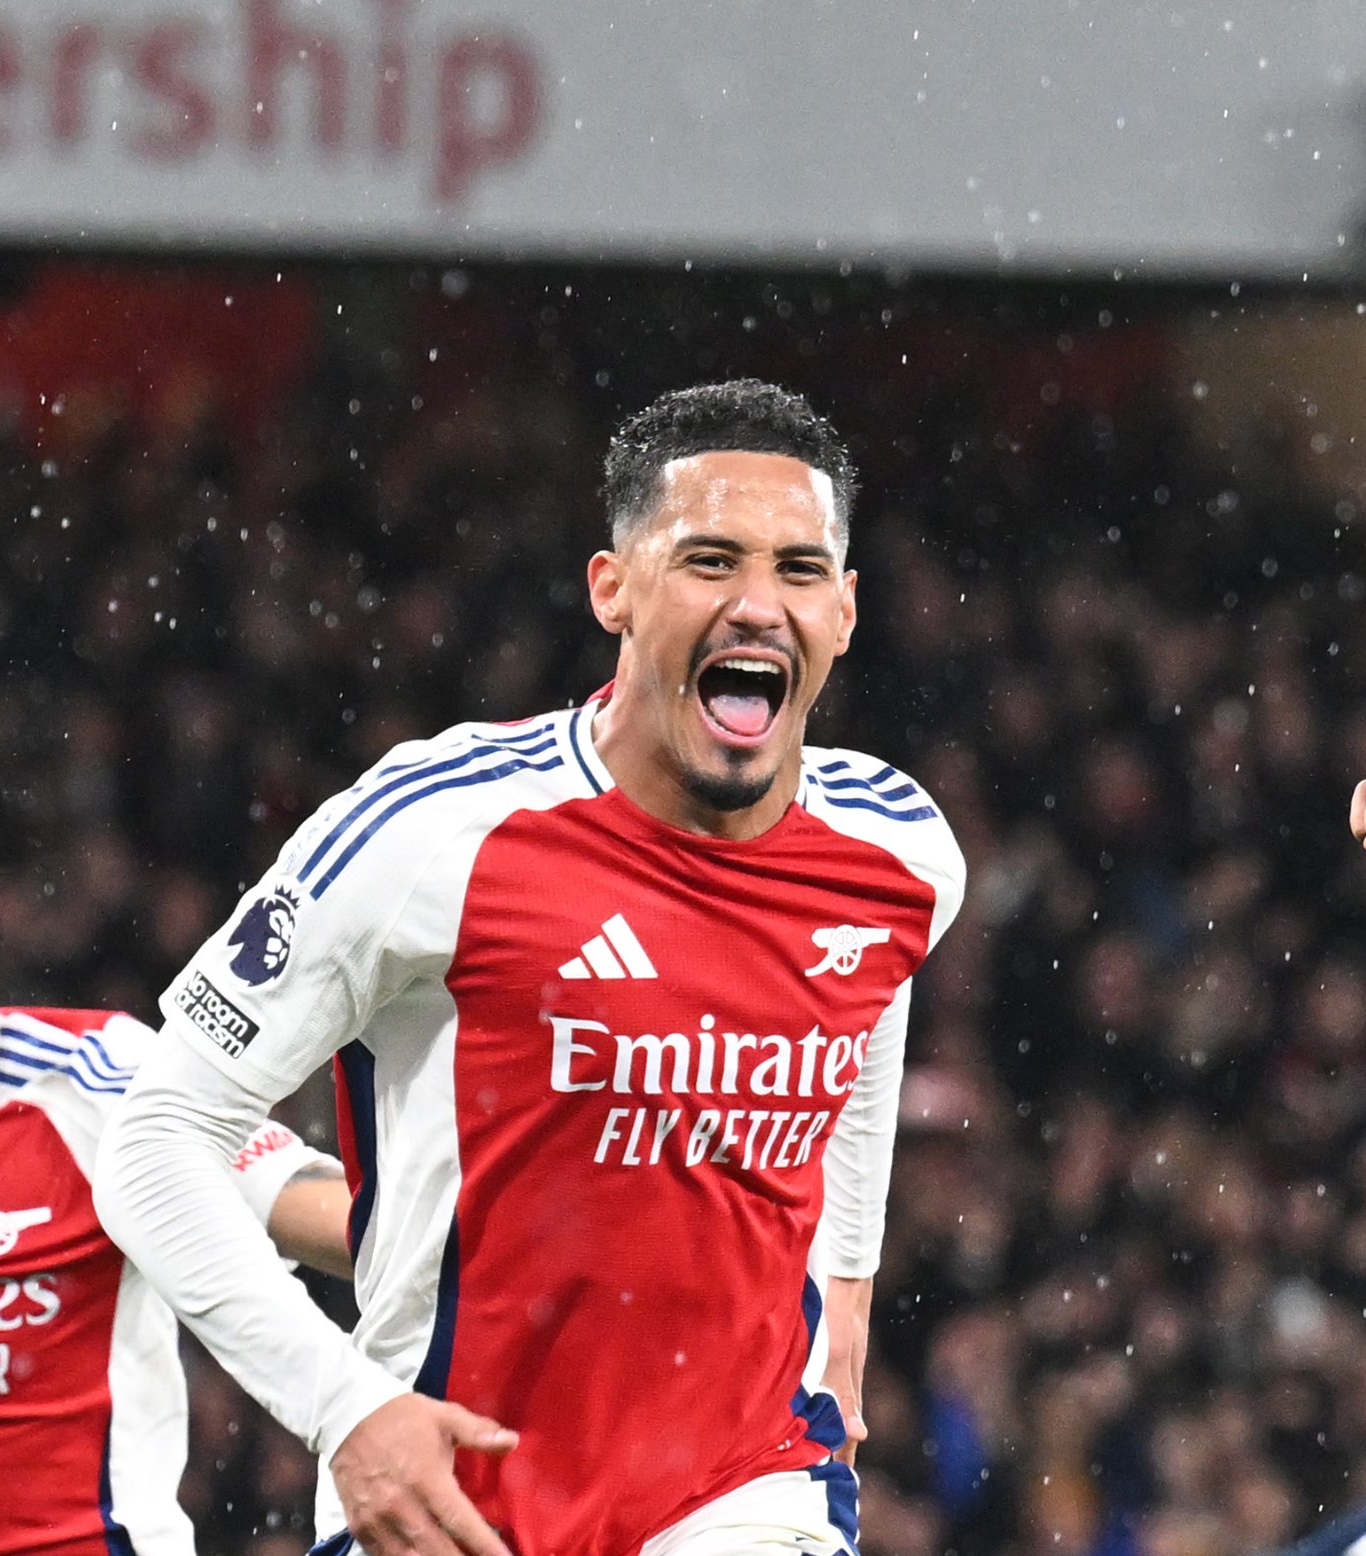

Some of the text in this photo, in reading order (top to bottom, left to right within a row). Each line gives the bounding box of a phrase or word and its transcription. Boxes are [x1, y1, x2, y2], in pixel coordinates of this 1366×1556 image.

[200, 989, 249, 1039] room
[593, 1107, 830, 1171] FLY BETTER
